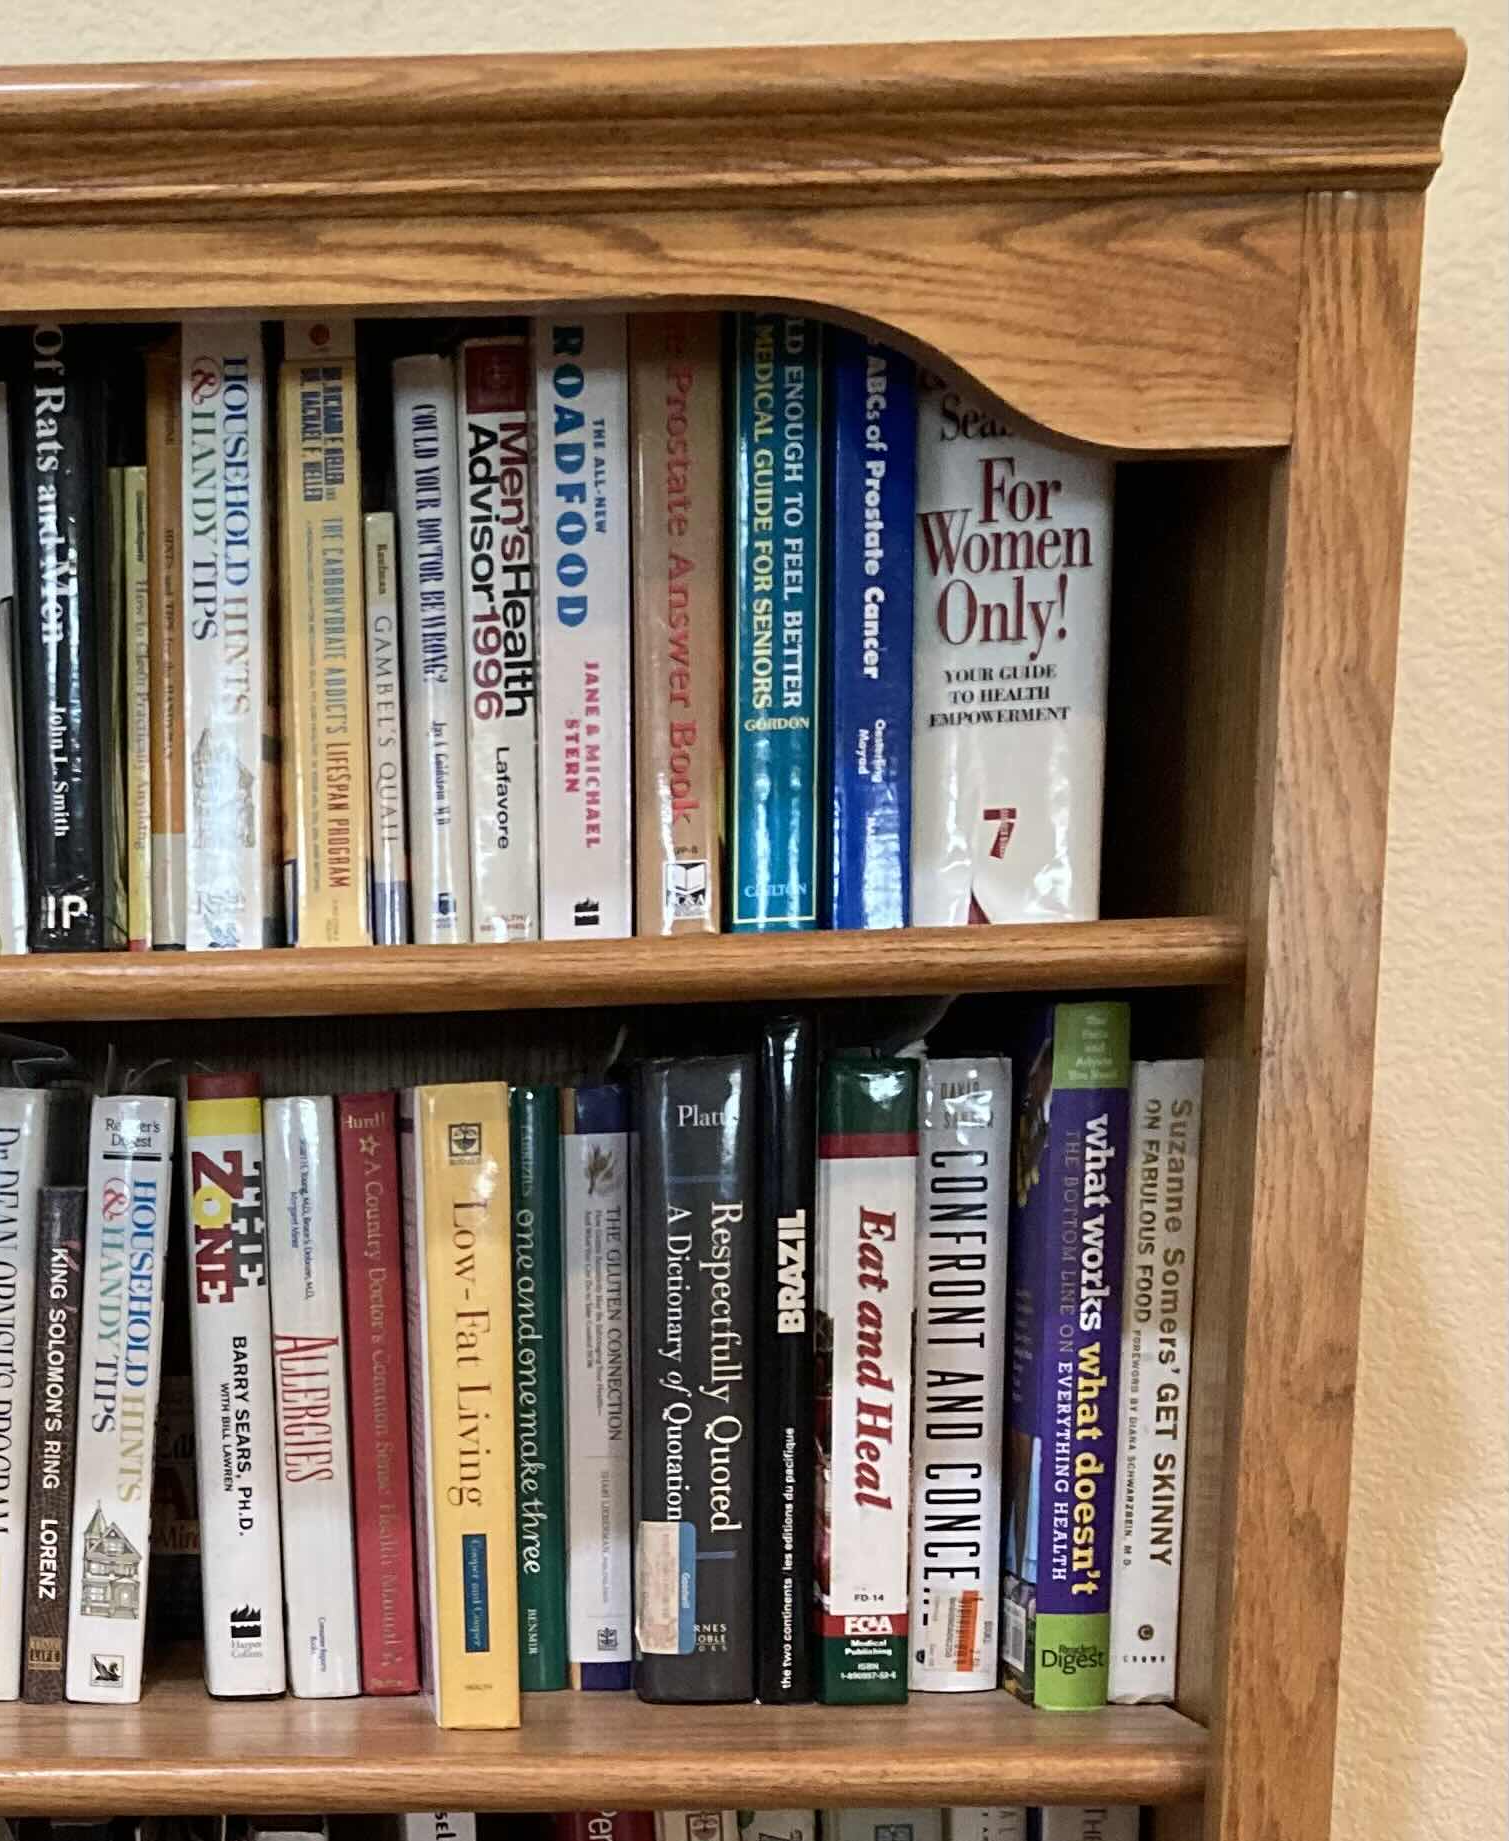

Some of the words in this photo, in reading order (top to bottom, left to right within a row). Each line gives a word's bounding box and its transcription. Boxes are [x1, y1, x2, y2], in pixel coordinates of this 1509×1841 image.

[593, 418, 605, 447] THE
[552, 327, 589, 628] ROADFOOD
[593, 456, 607, 534] ALL-NEW
[864, 459, 886, 577] Prostate
[977, 457, 1062, 523] For
[917, 510, 1093, 577] Women
[862, 587, 885, 680] Cancer
[936, 574, 1070, 661] Only!
[943, 667, 993, 683] YOUR
[998, 664, 1056, 680] GUIDE
[950, 691, 973, 704] TO
[979, 685, 1051, 702] HEALTH
[744, 717, 810, 731] GORDON
[928, 706, 1071, 728] EMPOWERMENT
[1084, 1114, 1109, 1208] what
[48, 1247, 69, 1301] KING
[777, 1208, 807, 1334] BRAZIL
[857, 1204, 898, 1292] Eat
[927, 1150, 987, 1349] CONFRONT
[1081, 1214, 1111, 1331] works
[45, 1309, 67, 1431] SOLOMON'S
[232, 1336, 250, 1400] BARRY
[857, 1301, 894, 1394] and
[926, 1366, 984, 1441] AND
[1077, 1342, 1108, 1444] what
[42, 1441, 62, 1490] RING
[234, 1407, 252, 1481] SEARS,
[853, 1398, 893, 1512] Heal
[38, 1518, 57, 1600] LORENZ
[1071, 1446, 1104, 1596] doesn't
